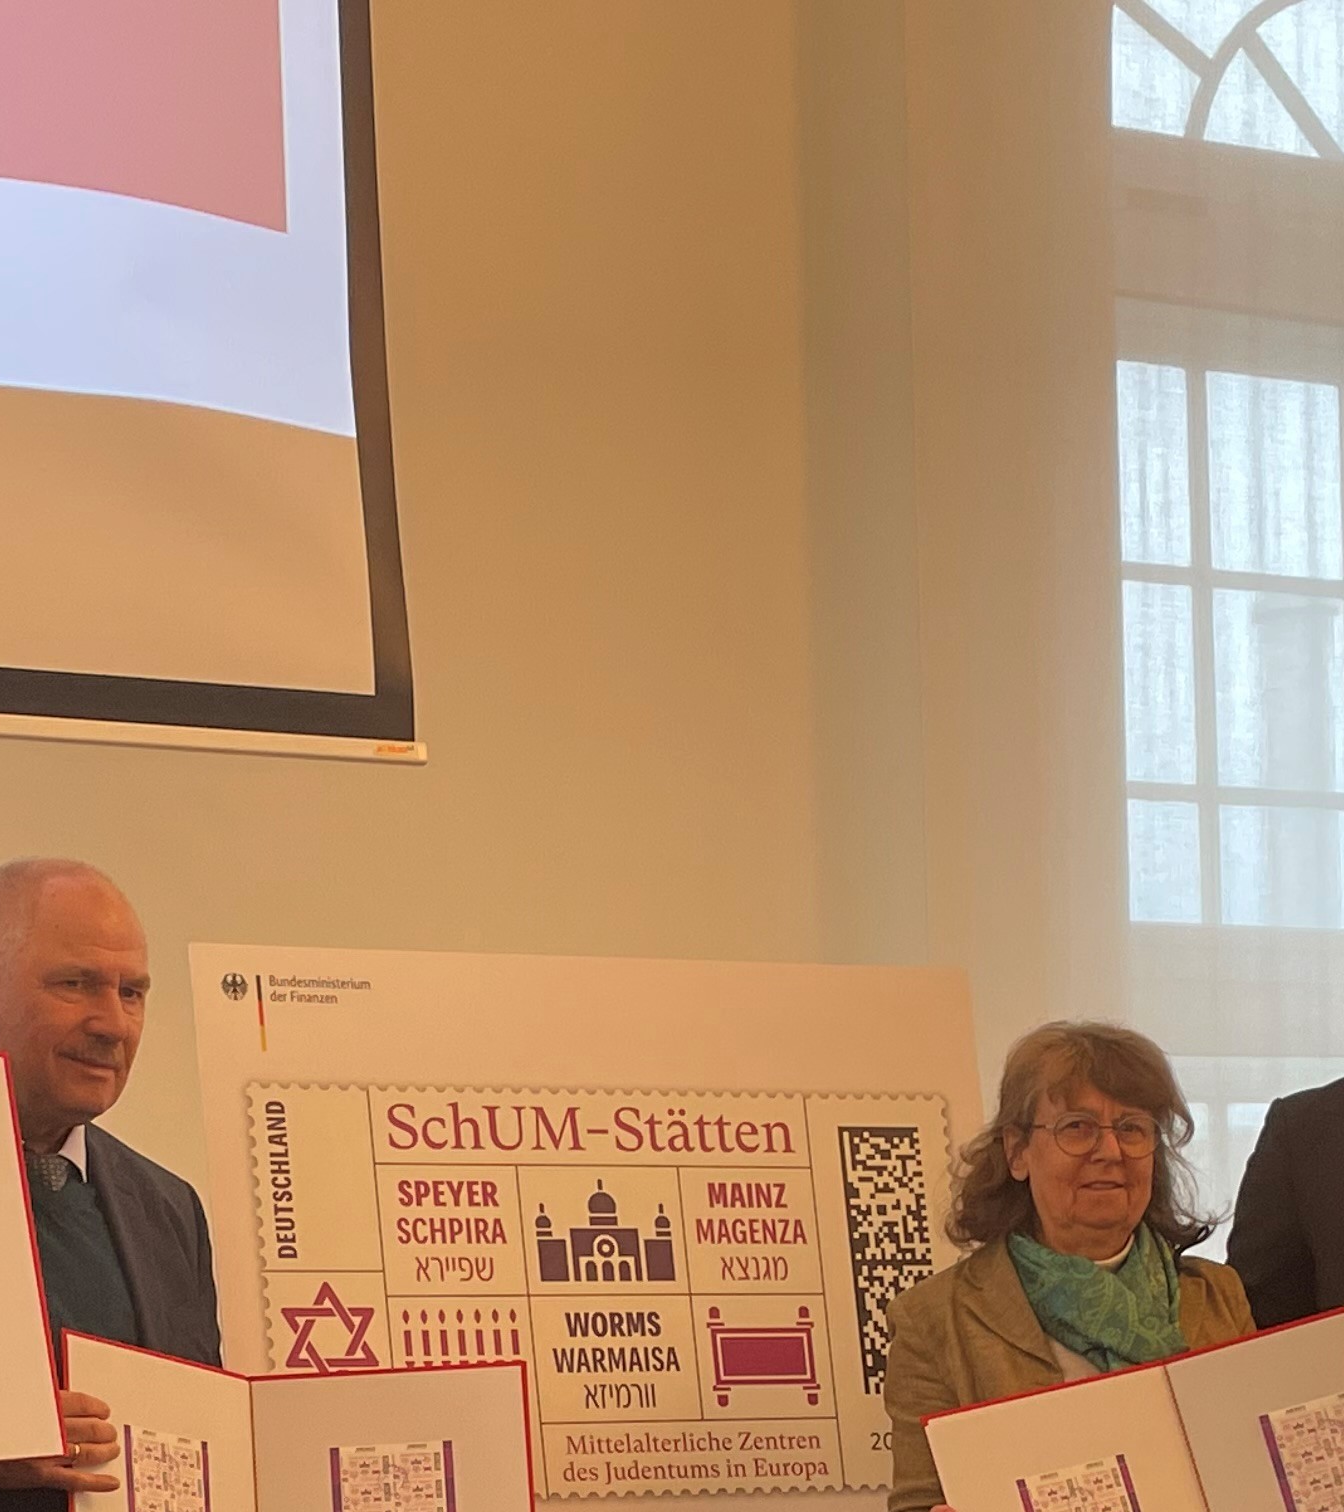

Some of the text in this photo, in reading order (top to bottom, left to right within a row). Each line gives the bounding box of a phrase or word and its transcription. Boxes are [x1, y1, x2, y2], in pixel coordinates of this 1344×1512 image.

[268, 975, 371, 990] Bundesministerium
[270, 991, 338, 1004] der Finanzen
[387, 1102, 795, 1153] SchUM-Stätten
[265, 1100, 298, 1259] DEUTSCHLAND
[397, 1180, 500, 1207] SPEYER
[707, 1182, 788, 1209] MAINZ
[396, 1217, 508, 1245] SCHPIRA
[696, 1218, 808, 1246] MAGENZA
[564, 1311, 662, 1338] WORMS
[552, 1346, 681, 1374] WARMAISA
[565, 1431, 821, 1455] Mittelalterliche Zentren
[563, 1459, 829, 1485] des Judentums in Europa
